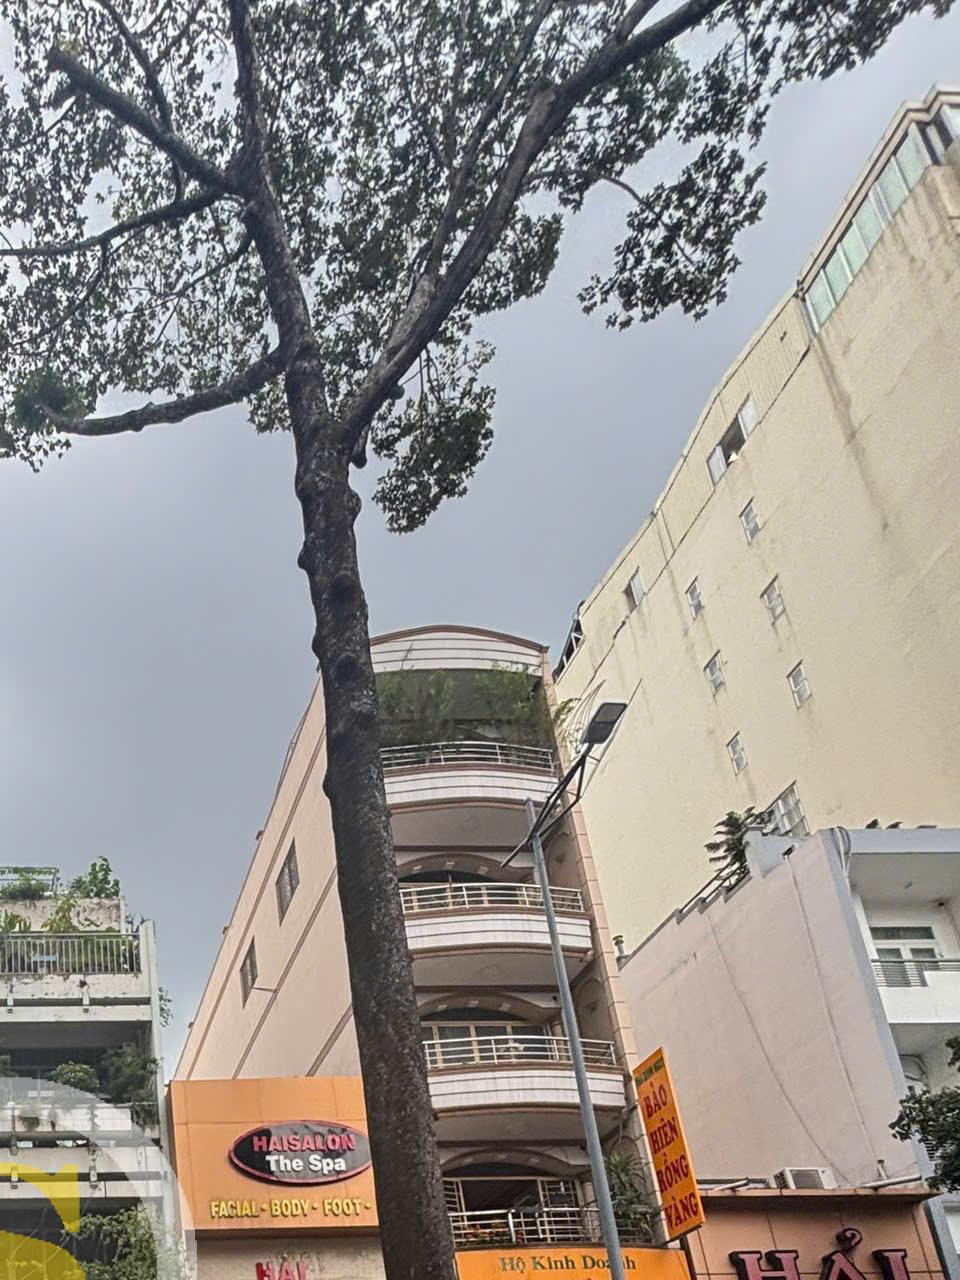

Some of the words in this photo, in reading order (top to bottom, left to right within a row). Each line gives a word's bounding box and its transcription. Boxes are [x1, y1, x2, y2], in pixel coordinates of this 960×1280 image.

[265, 1155, 304, 1171] The
[309, 1154, 347, 1174] Spa
[210, 1201, 260, 1218] FACIAL
[270, 1199, 309, 1217] BODY
[323, 1198, 362, 1216] FOOT
[531, 1255, 576, 1271] Kinh
